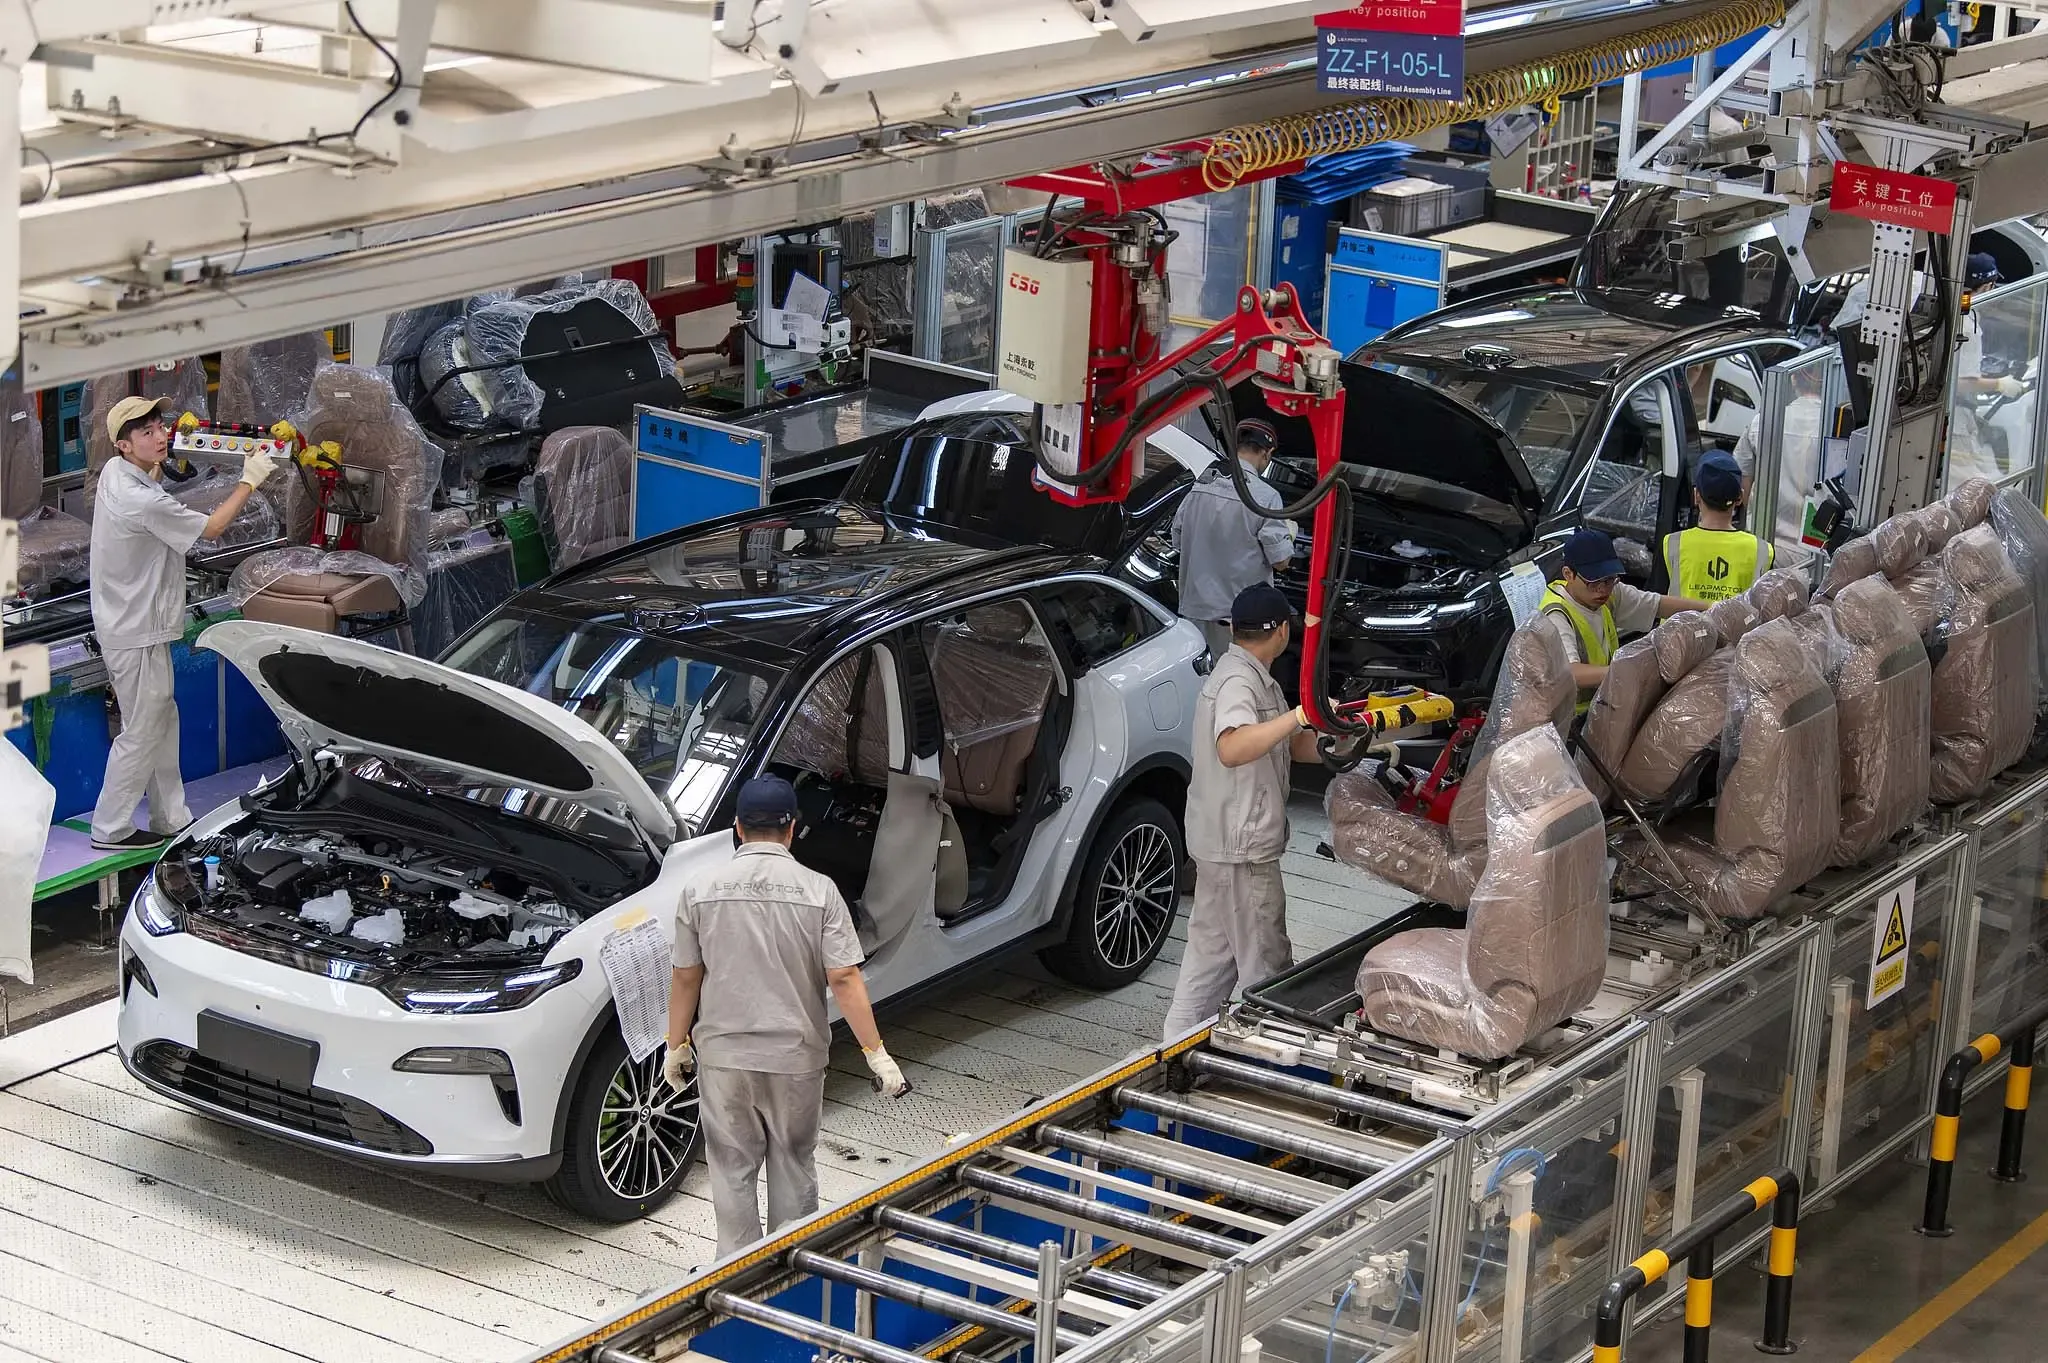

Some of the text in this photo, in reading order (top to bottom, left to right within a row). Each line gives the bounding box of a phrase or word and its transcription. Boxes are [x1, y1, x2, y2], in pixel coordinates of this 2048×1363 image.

[1377, 6, 1427, 19] position
[1326, 48, 1451, 78] ZZ-F1-05-L
[1327, 77, 1382, 91] 最终装配线
[1386, 84, 1452, 95] Final Assembly Line
[1852, 179, 1934, 208] 关键工位
[1858, 198, 1924, 218] Key position
[1009, 272, 1040, 295] CSG
[714, 881, 804, 896] LEAPMOTOR
